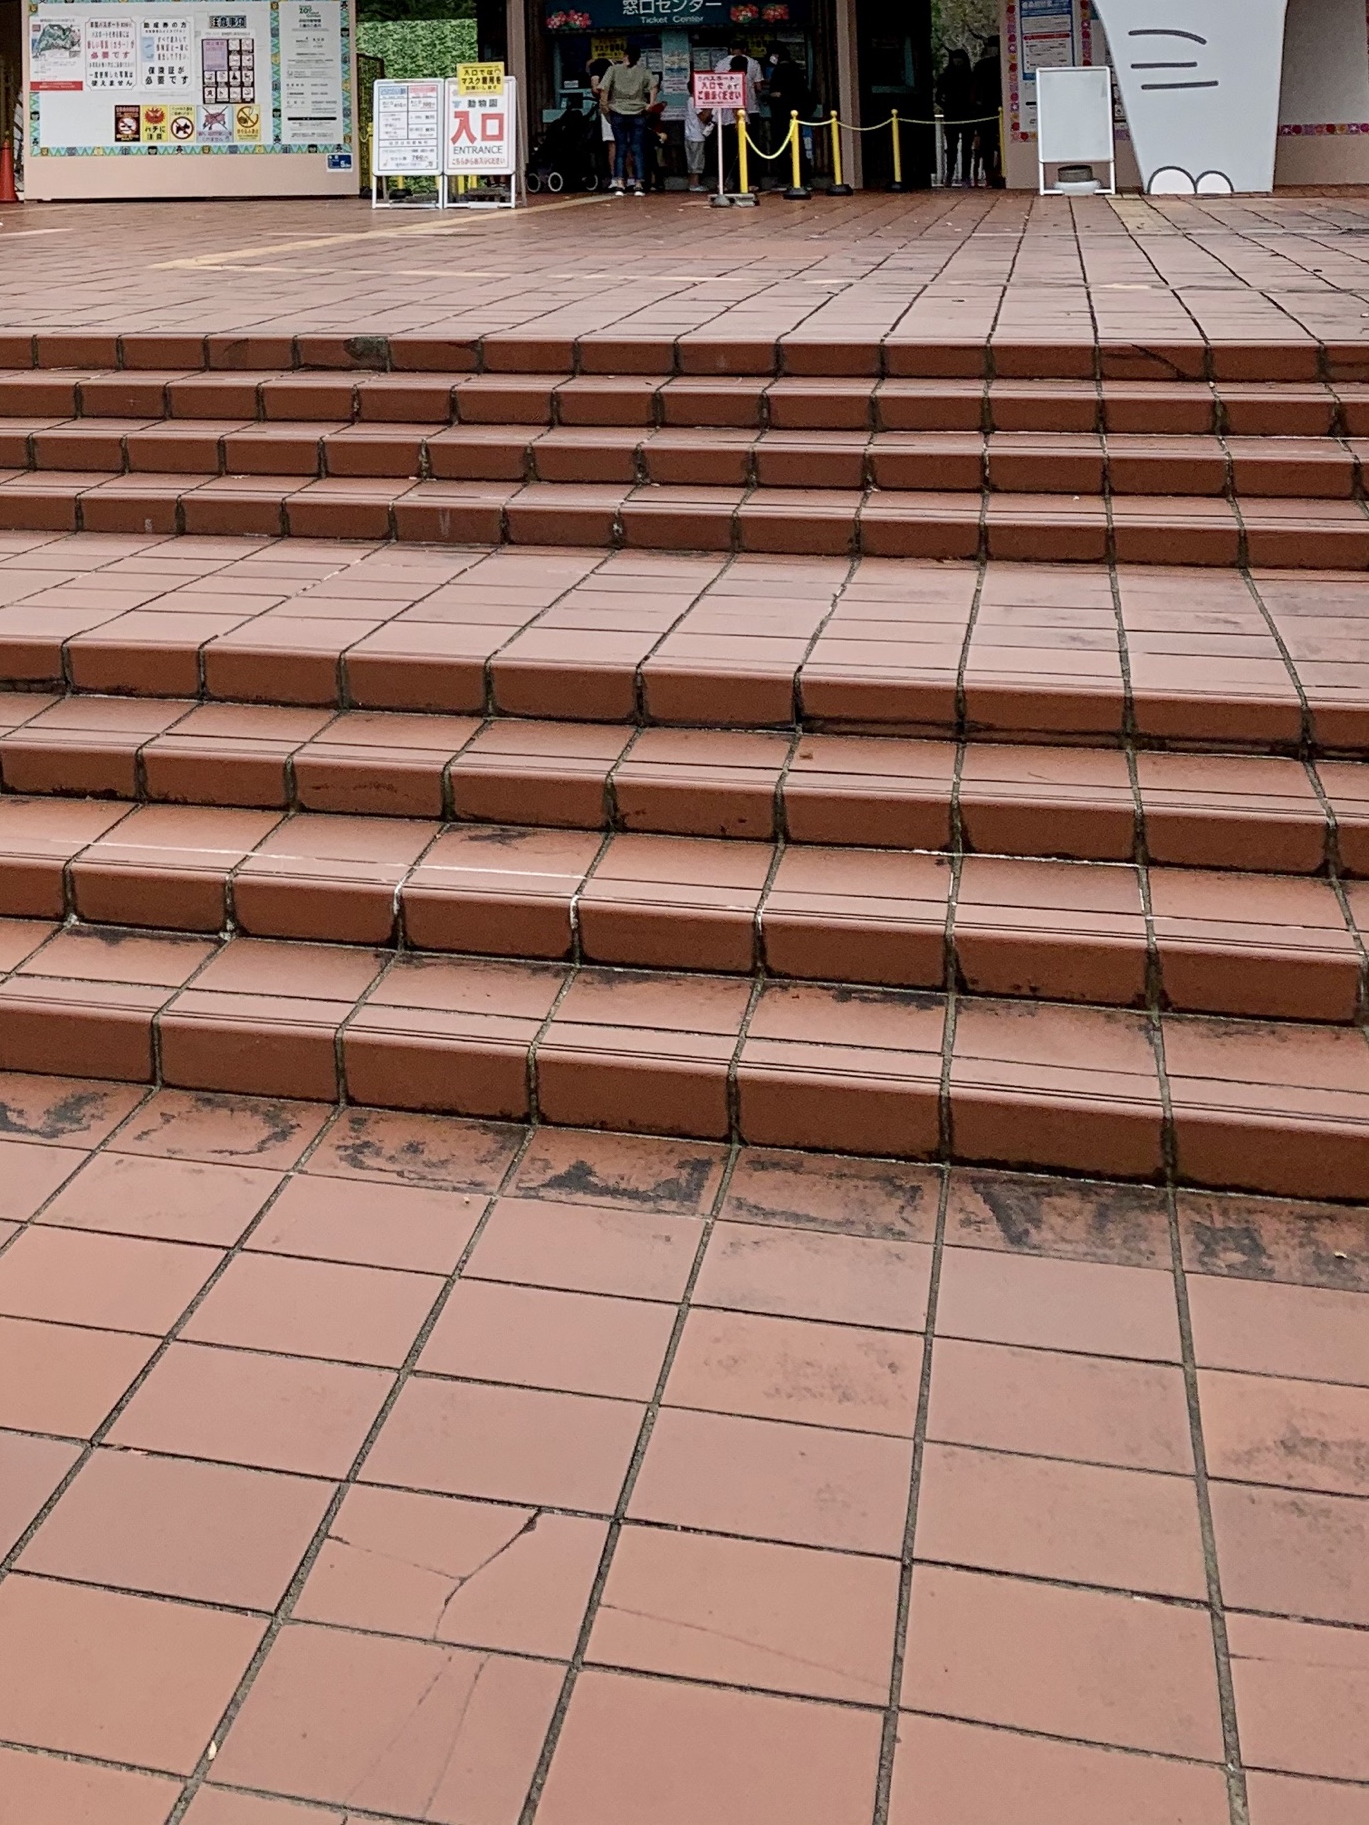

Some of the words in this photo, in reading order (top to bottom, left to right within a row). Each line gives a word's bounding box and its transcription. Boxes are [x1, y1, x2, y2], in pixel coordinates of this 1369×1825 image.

[640, 16, 668, 24] Ticket
[672, 14, 704, 23] Center
[450, 110, 505, 145] 入口
[453, 145, 503, 154] ENTRANCE
